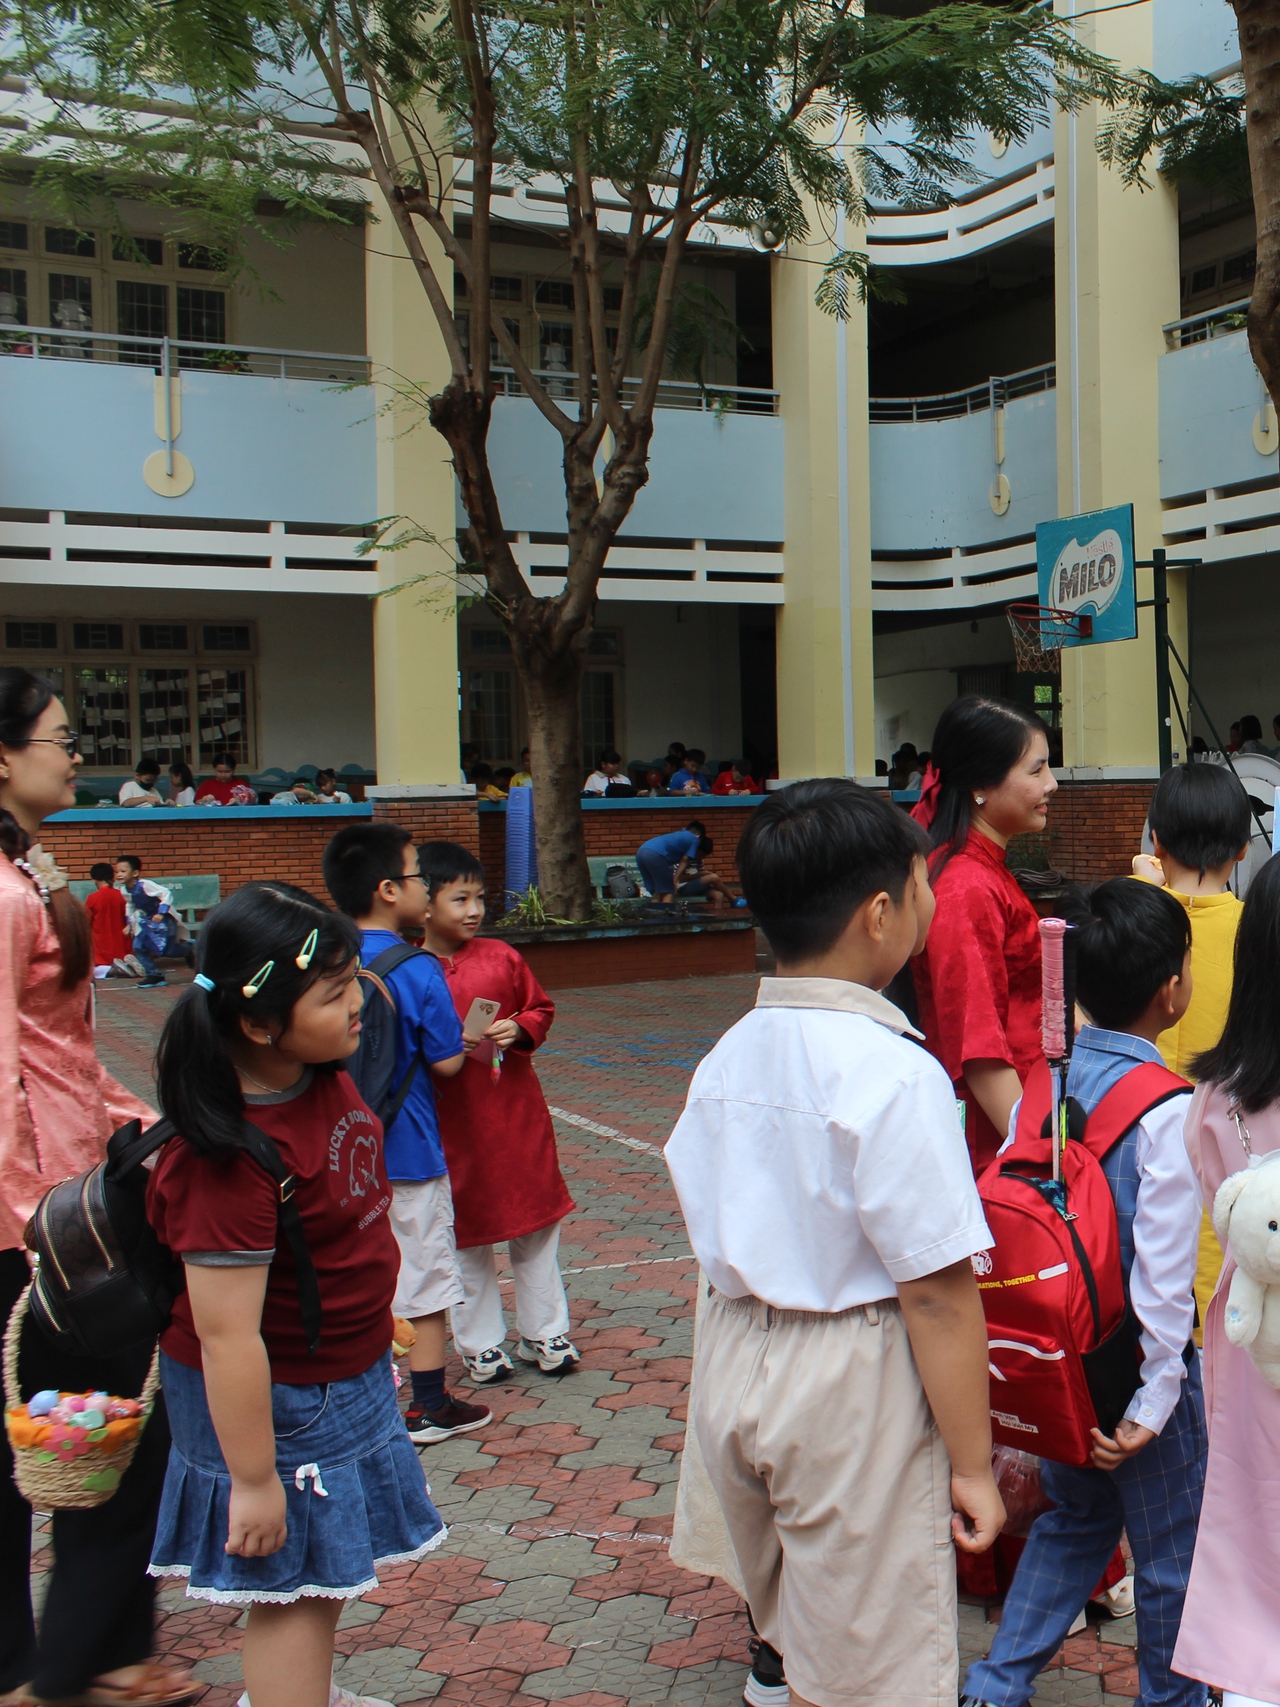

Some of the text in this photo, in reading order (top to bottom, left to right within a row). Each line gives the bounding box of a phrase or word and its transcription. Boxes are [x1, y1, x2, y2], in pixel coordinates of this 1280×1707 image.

[1058, 553, 1117, 604] MILO
[329, 1110, 374, 1172] LUCKY BOBA
[358, 1204, 383, 1230] BUBBLE
[1003, 1274, 1036, 1287] TOGETHER
